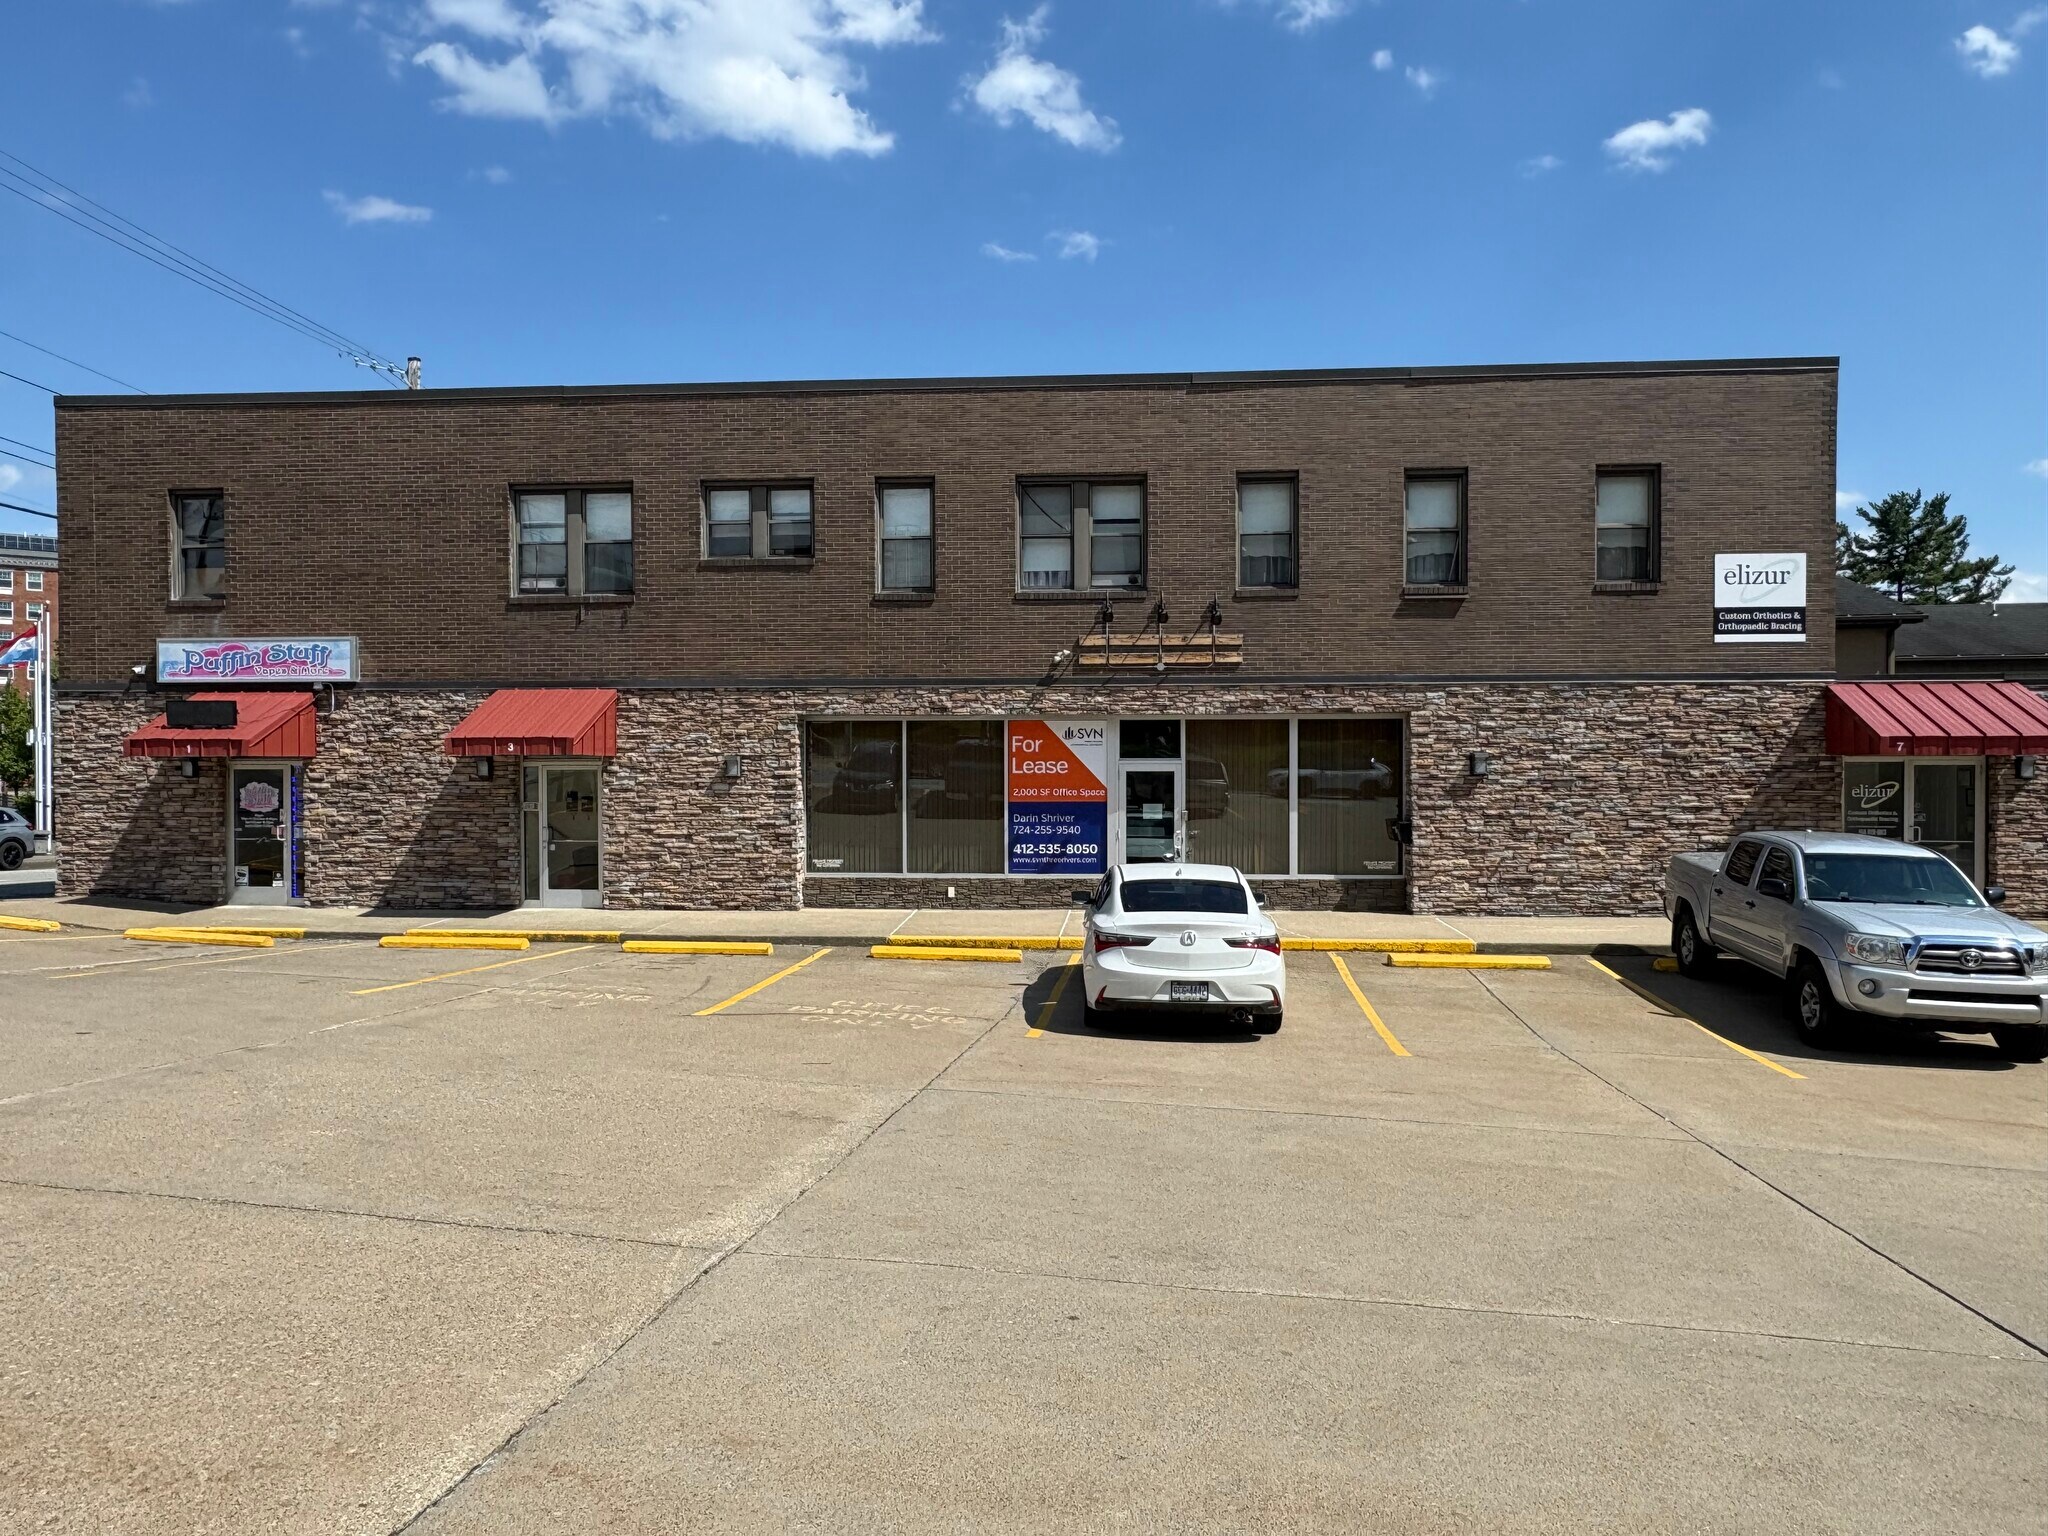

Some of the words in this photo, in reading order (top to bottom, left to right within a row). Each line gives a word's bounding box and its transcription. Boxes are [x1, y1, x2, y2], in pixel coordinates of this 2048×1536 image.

[1723, 564, 1791, 585] elizur
[1718, 612, 1751, 620] Custom
[1752, 612, 1792, 620] Orthotics
[1793, 612, 1801, 620] &
[1718, 622, 1769, 631] Orthopaedic
[1770, 622, 1803, 631] Bracing
[181, 648, 262, 677] Puffin
[267, 644, 331, 667] Stuff
[254, 666, 288, 676] Vapes
[290, 666, 298, 675] &
[301, 666, 330, 675] More
[1077, 727, 1103, 739] SVN
[186, 744, 191, 753] 1
[507, 742, 514, 751] 3
[1012, 735, 1043, 753] For
[1896, 742, 1904, 751] 7
[1012, 757, 1068, 774] Lease
[1013, 788, 1038, 797] 2,000
[1040, 788, 1051, 796] SF
[1052, 788, 1077, 796] Office
[1079, 788, 1106, 797] Space
[1851, 784, 1895, 798] elizur
[1013, 814, 1038, 822] Darin
[1041, 814, 1075, 822] Shriver
[1013, 825, 1081, 835] 724-255-9540
[1013, 843, 1098, 854] 412-535-8050
